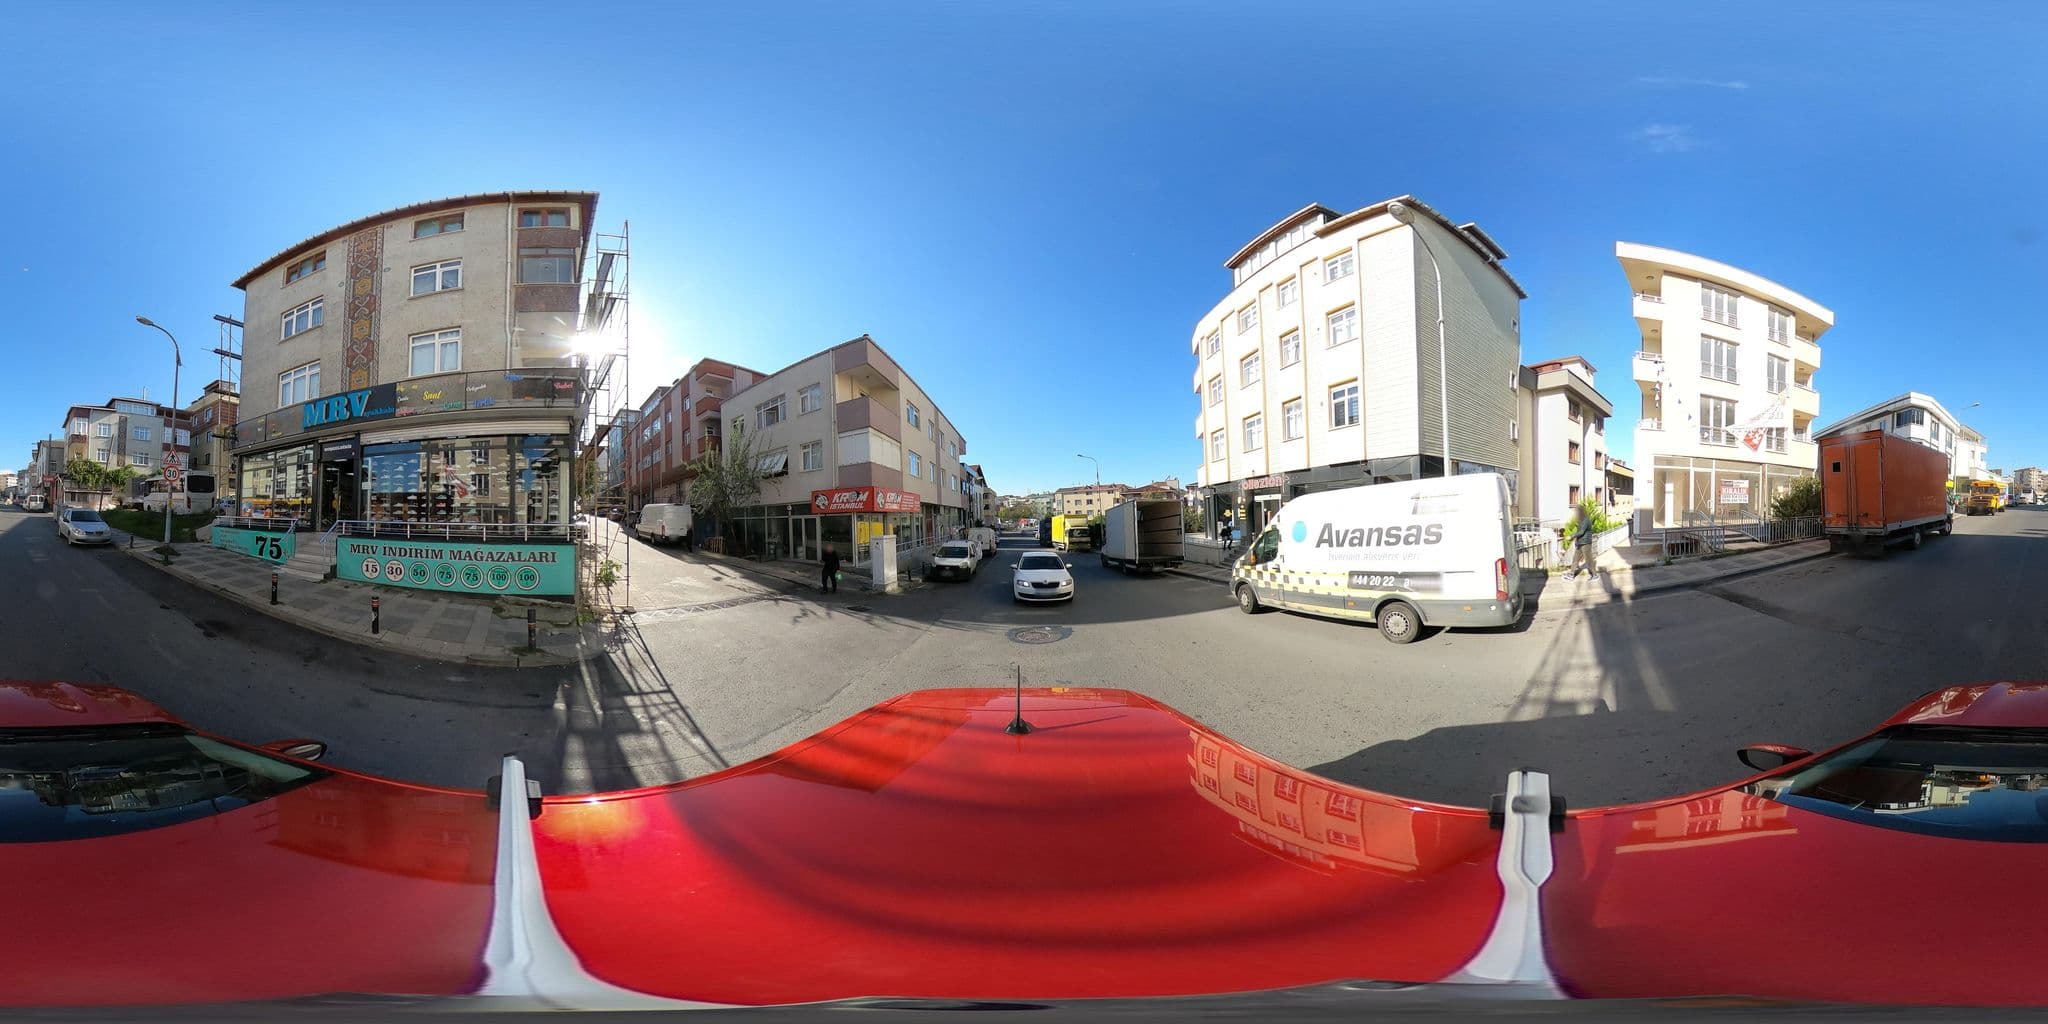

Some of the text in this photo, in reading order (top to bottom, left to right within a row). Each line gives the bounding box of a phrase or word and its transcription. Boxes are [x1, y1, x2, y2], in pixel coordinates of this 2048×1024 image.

[303, 390, 372, 429] MRV
[167, 469, 177, 479] 30
[832, 491, 869, 503] KROM
[1315, 522, 1443, 548] Avansas
[255, 536, 282, 559] 75
[350, 543, 557, 562] MRV İNDİRİM MAĞAZALARI
[364, 563, 535, 581] 15 30 50 75 75 100 100
[1369, 575, 1381, 586] 20
[1382, 575, 1395, 587] 22
